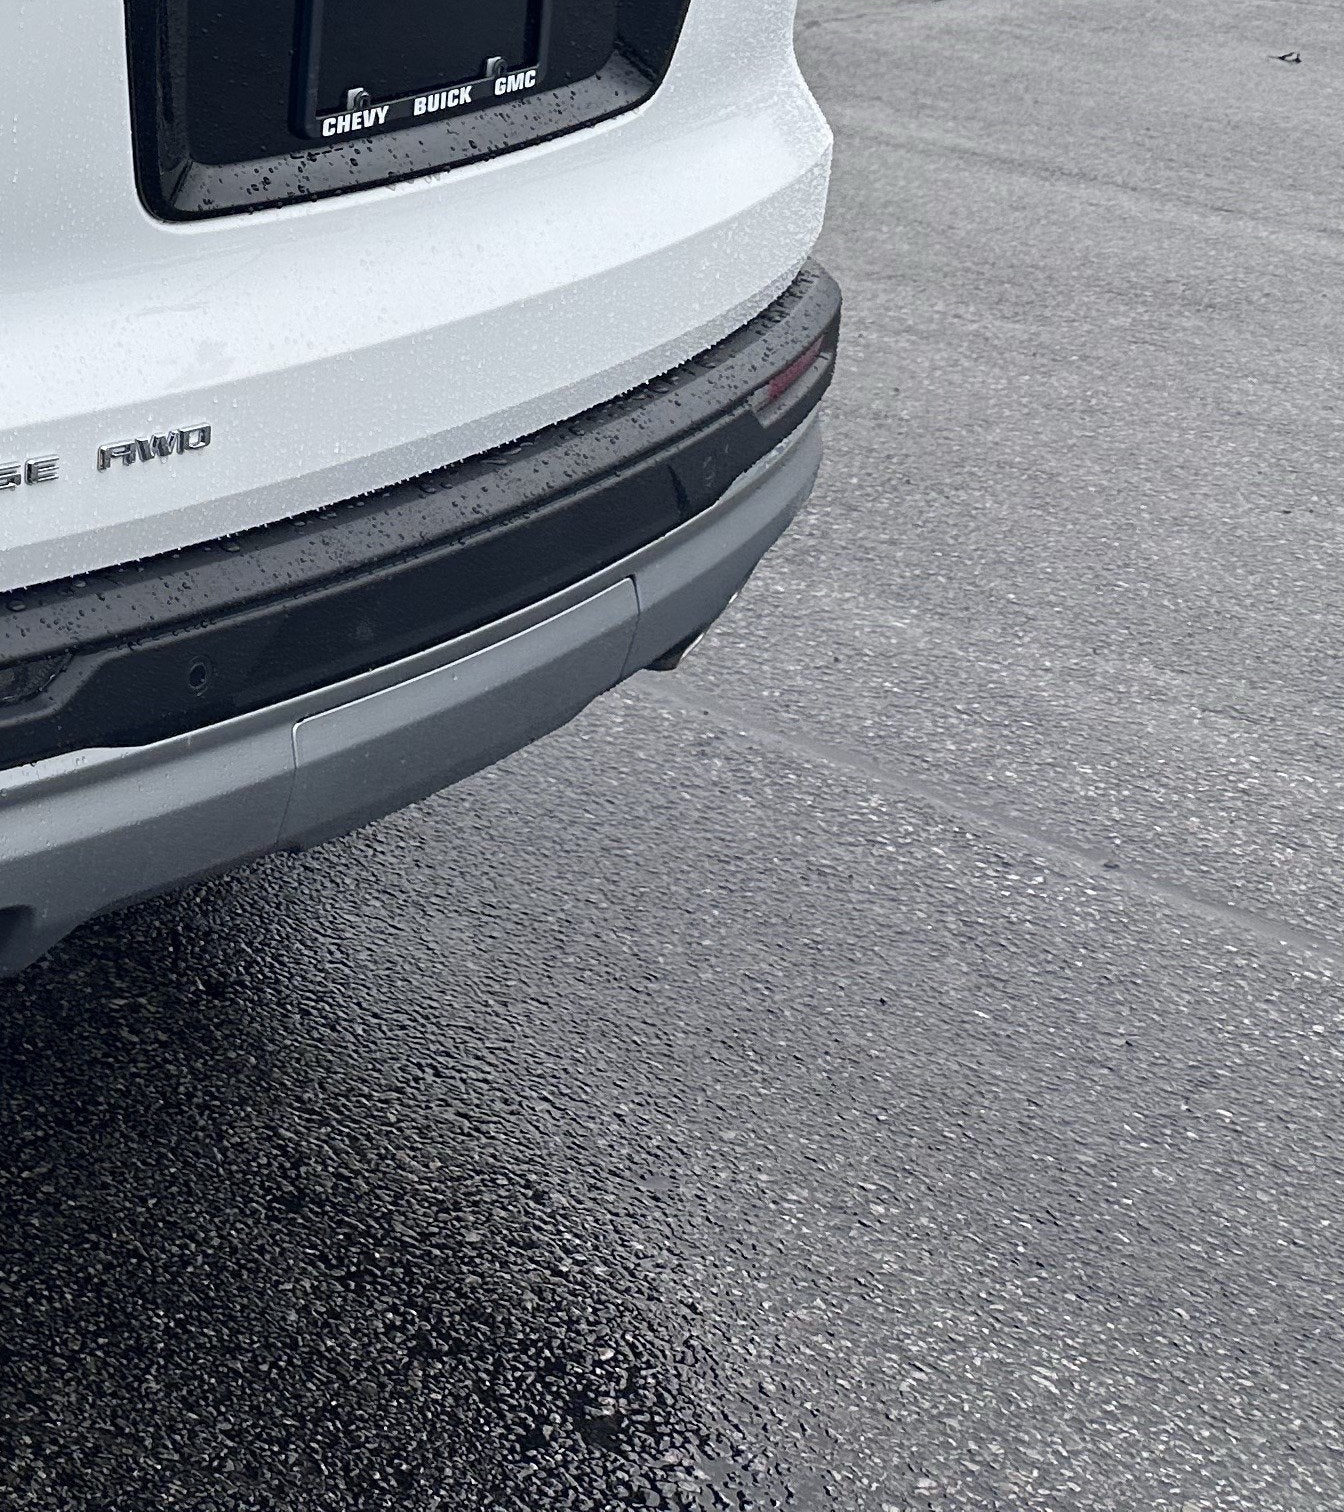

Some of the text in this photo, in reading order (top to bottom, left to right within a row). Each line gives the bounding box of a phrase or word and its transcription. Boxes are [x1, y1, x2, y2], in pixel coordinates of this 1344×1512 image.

[322, 70, 537, 137] CHEVY BUICK GMC
[97, 422, 212, 472] AWD
